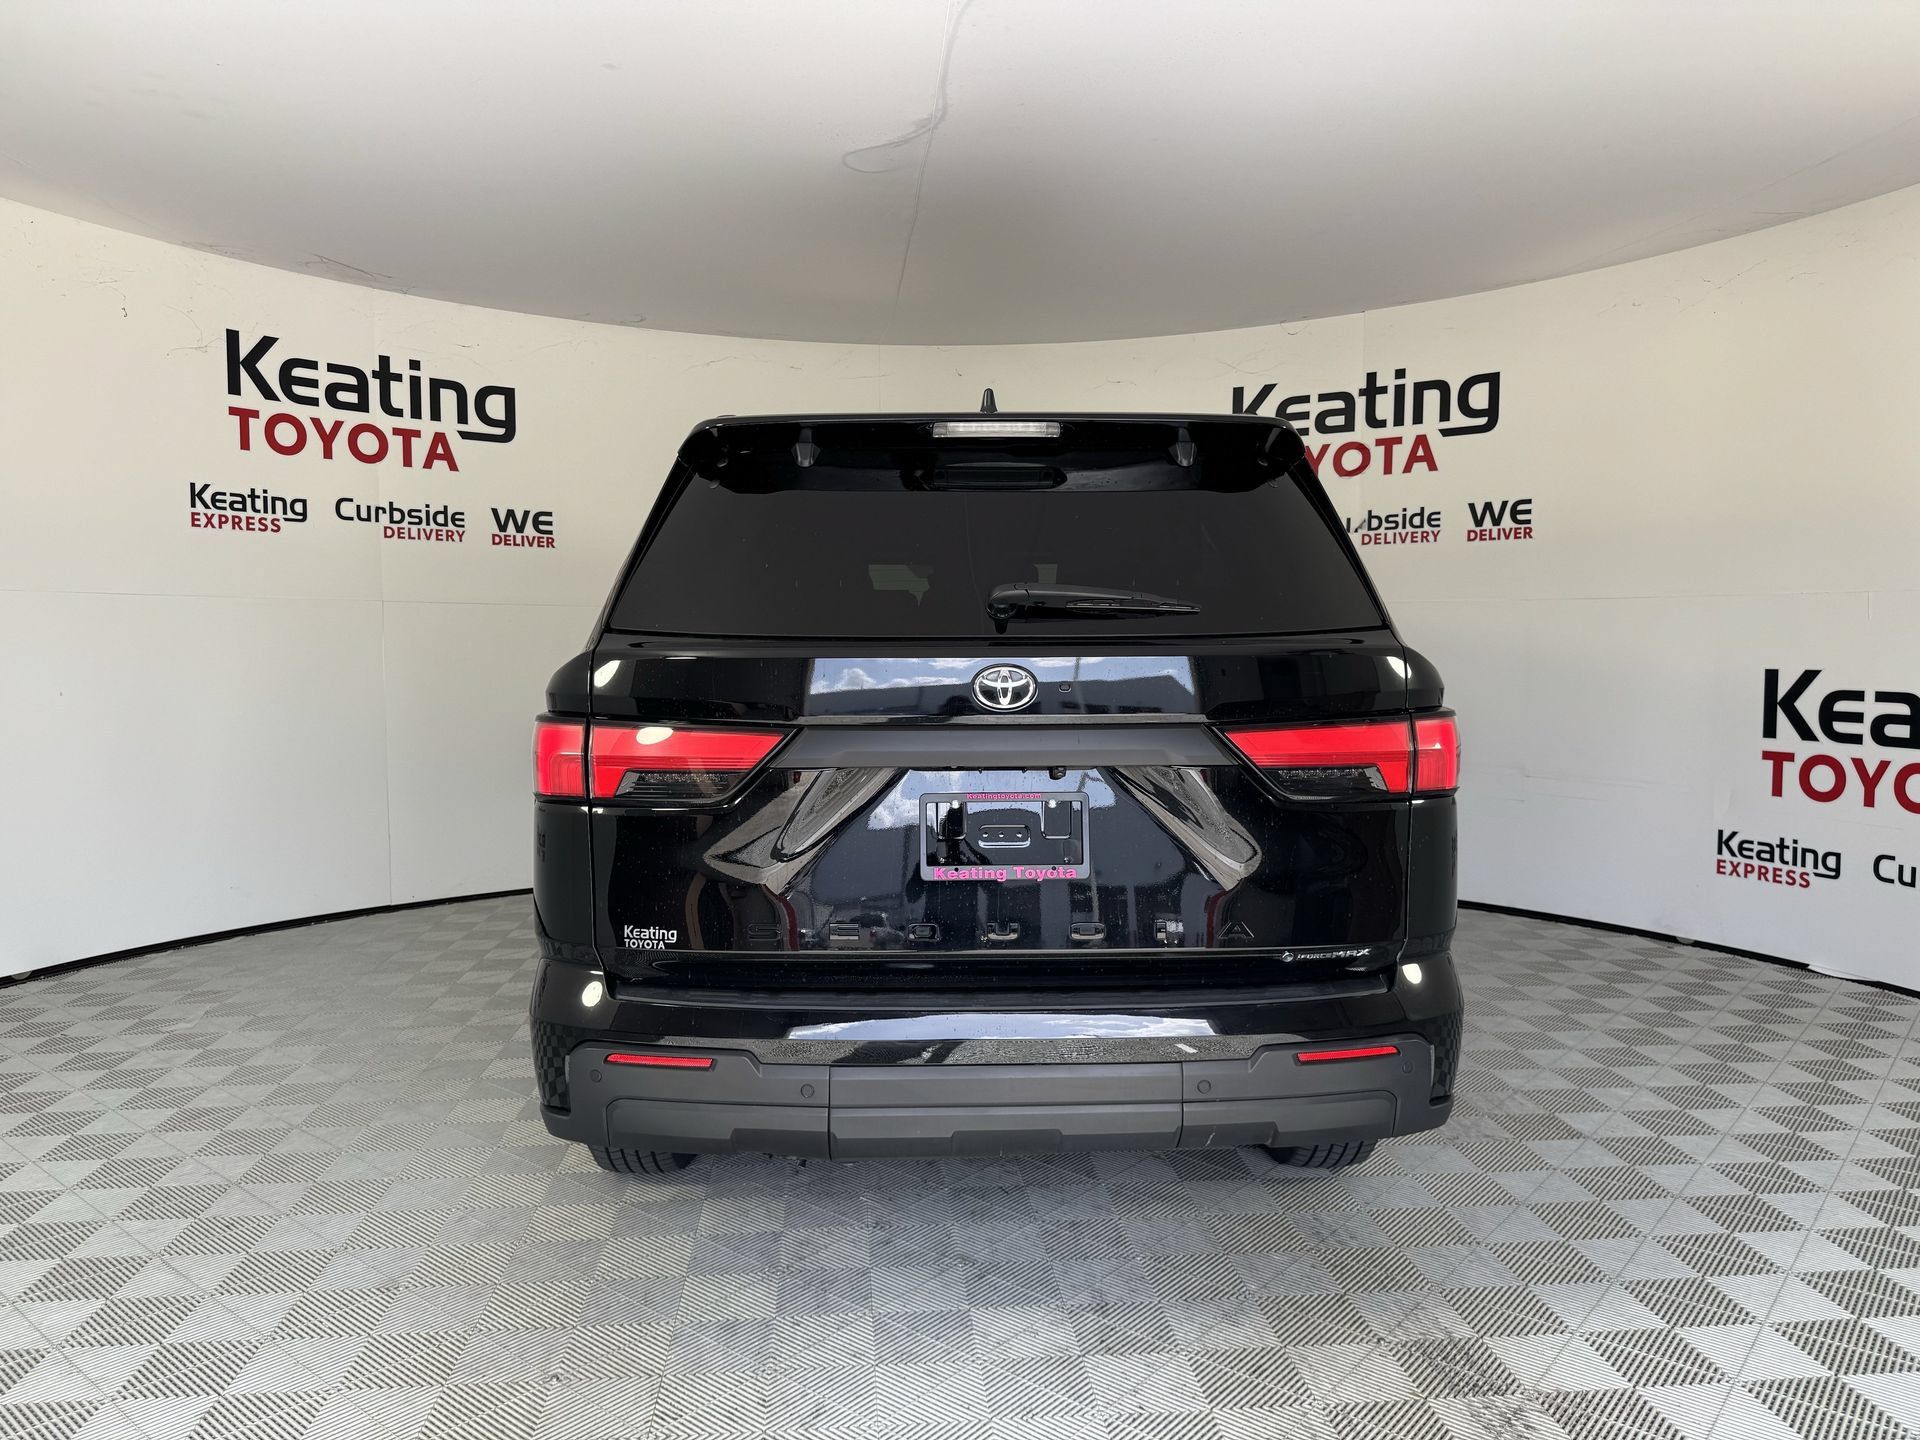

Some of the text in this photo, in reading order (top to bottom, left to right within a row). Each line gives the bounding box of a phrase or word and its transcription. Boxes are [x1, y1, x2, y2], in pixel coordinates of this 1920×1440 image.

[226, 328, 516, 443] Keating
[228, 406, 460, 472] TOYOTA
[189, 482, 308, 523] Keating
[335, 497, 465, 529] Curbside
[1468, 498, 1533, 528] WE
[190, 511, 282, 534] EXPRESS
[383, 525, 466, 543] DELIVERY
[491, 507, 553, 536] WE
[1466, 526, 1534, 542] DELIVER
[491, 533, 556, 549] DELIVER
[1361, 529, 1441, 546] DELIVERY
[1716, 828, 1842, 881] Keating
[933, 866, 1078, 882] Keating Toyota
[1716, 858, 1811, 889] EXPRESS
[623, 924, 678, 943] Keating
[623, 938, 666, 950] TOYOTA
